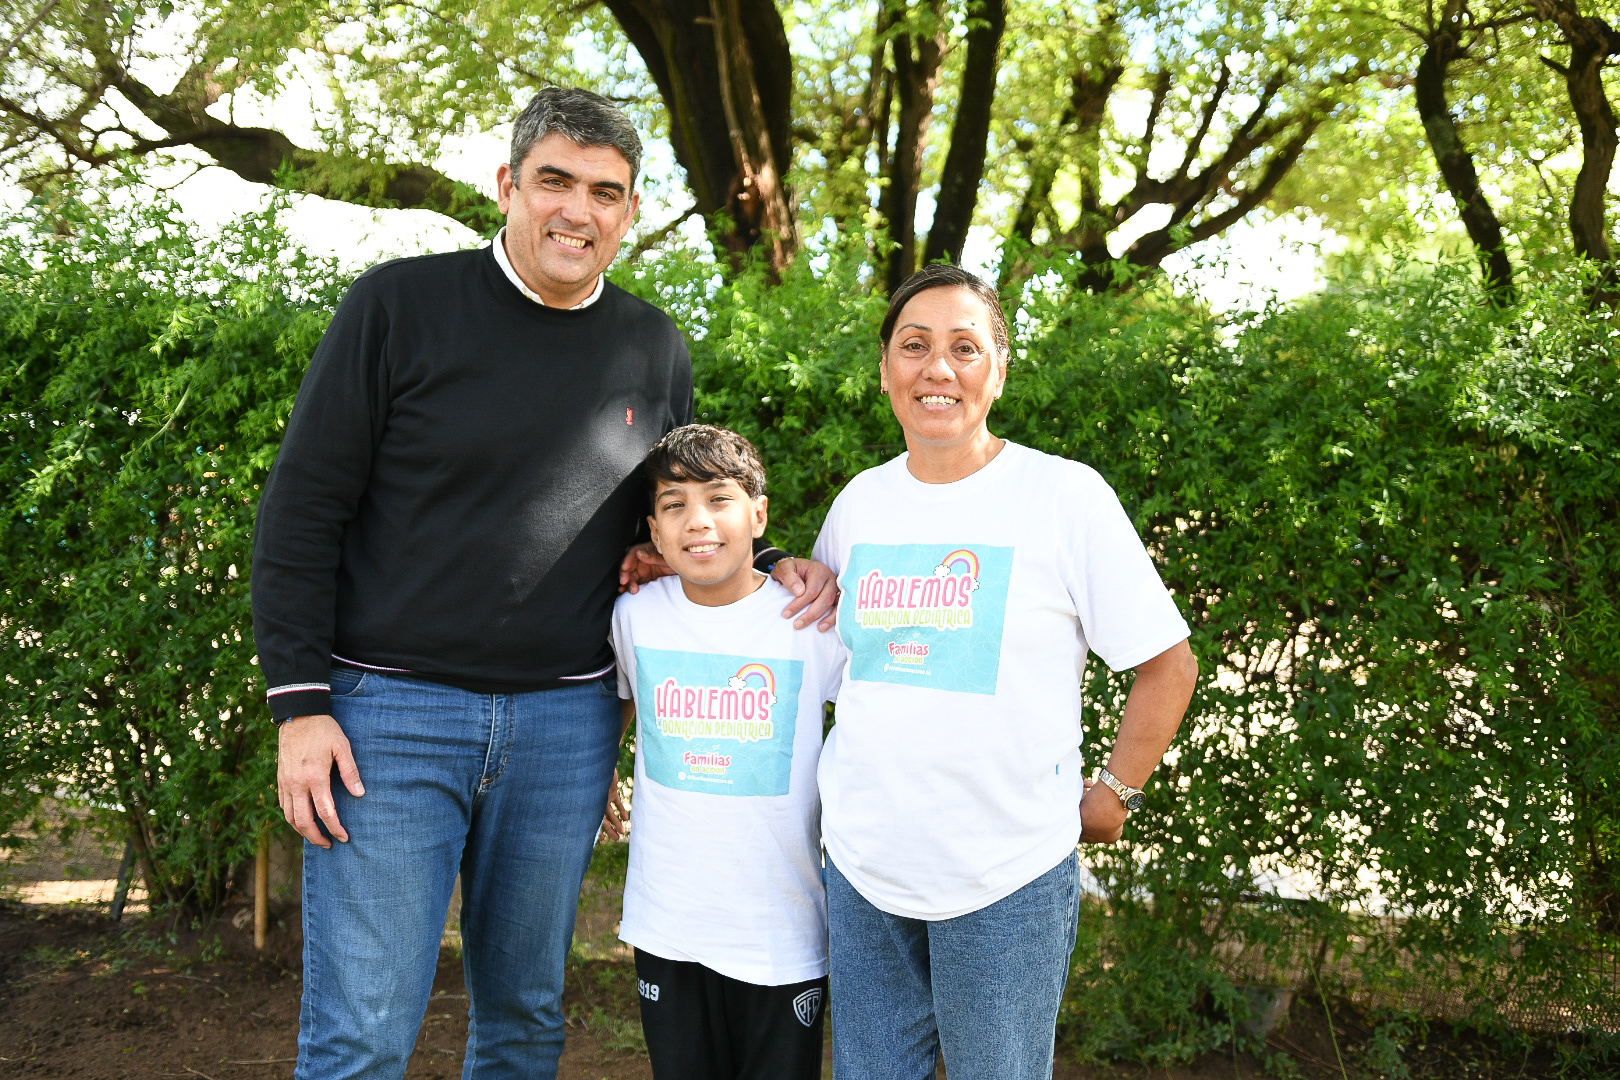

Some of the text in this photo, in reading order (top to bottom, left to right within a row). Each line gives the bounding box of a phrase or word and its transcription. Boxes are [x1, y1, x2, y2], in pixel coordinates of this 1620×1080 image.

[857, 571, 972, 610] HABLEMOS
[888, 641, 929, 656] Familias
[656, 679, 769, 721] HABLEMOS
[684, 751, 731, 767] Familias
